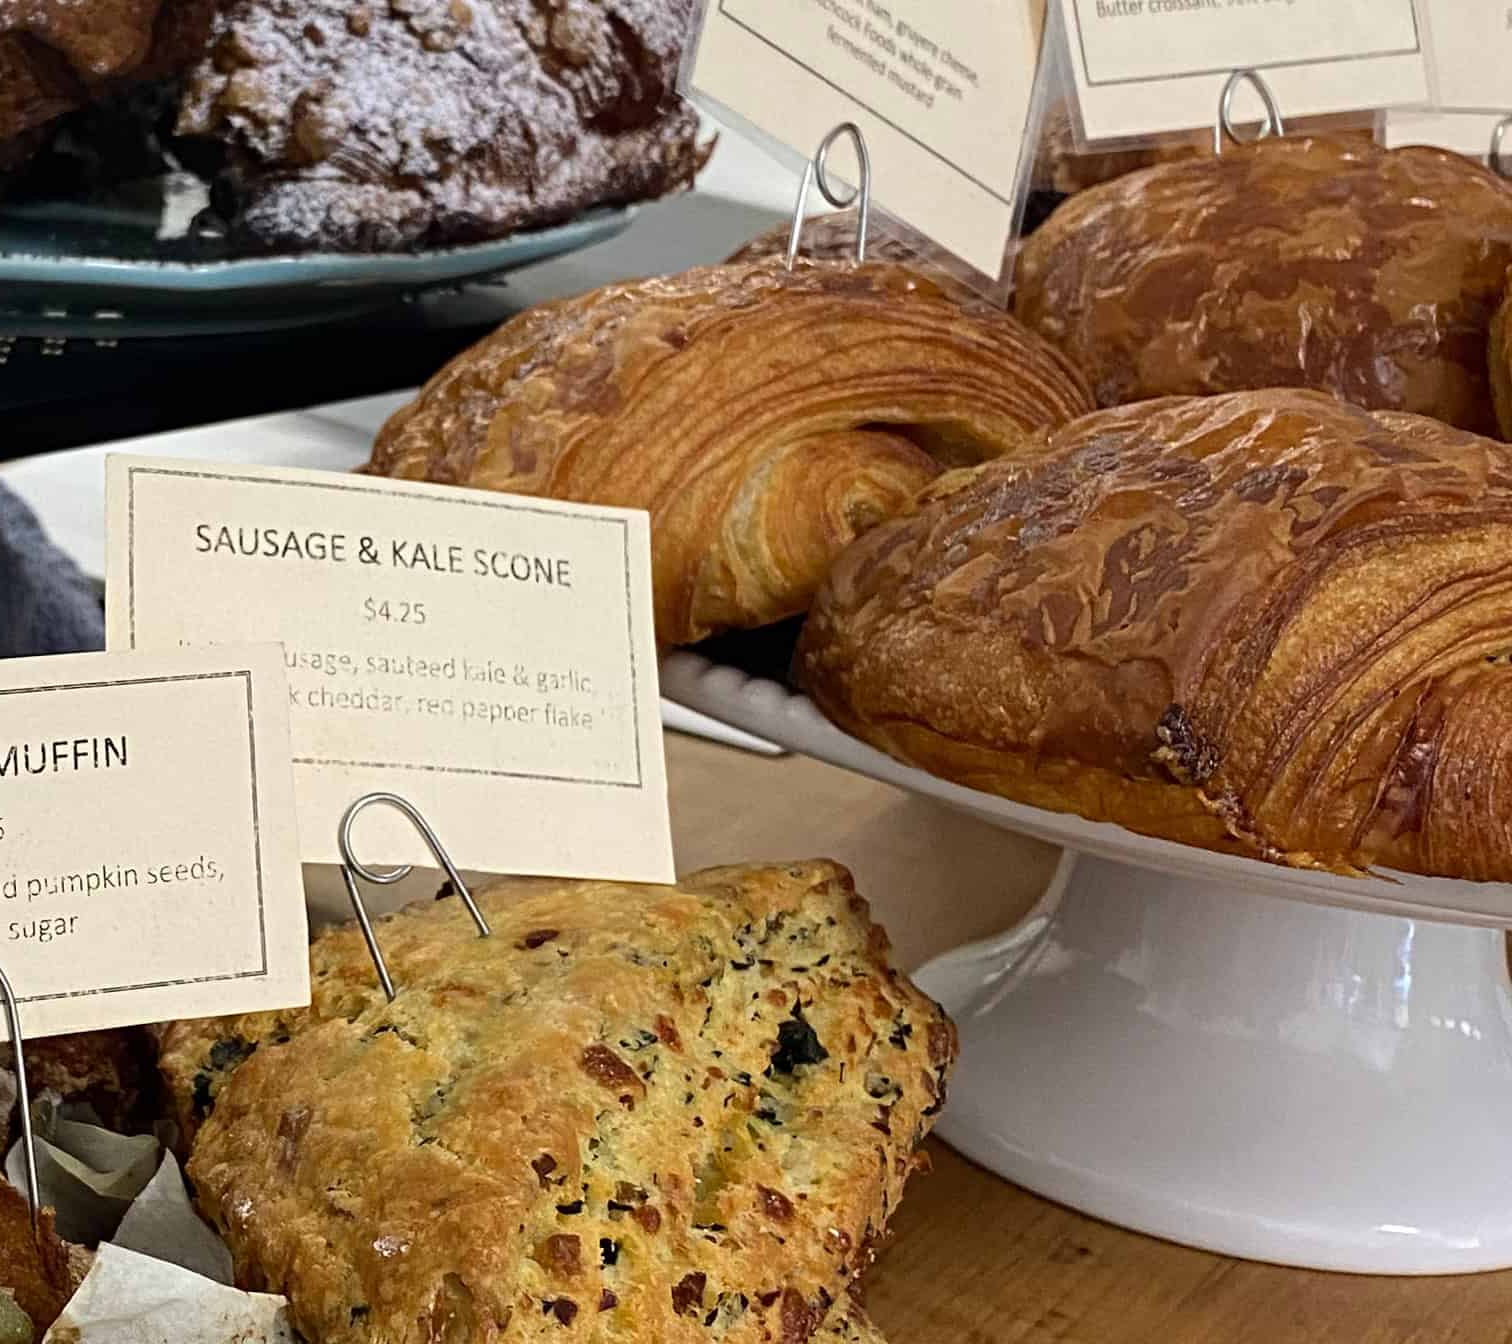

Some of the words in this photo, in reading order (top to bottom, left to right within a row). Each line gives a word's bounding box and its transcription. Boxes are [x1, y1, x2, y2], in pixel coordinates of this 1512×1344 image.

[196, 525, 346, 564] SAUSAGE
[358, 537, 382, 564] &
[393, 541, 463, 574] KALE
[474, 551, 571, 587] SCONE
[364, 598, 426, 624] $4.25
[285, 651, 359, 675] usage,
[367, 655, 456, 679] sauteed
[463, 658, 505, 684] kale
[513, 665, 529, 688] &
[417, 695, 453, 715] red
[462, 701, 538, 724] pepper
[27, 866, 138, 903] pumpkin
[147, 856, 225, 887] seeds,
[9, 912, 78, 945] sugar
